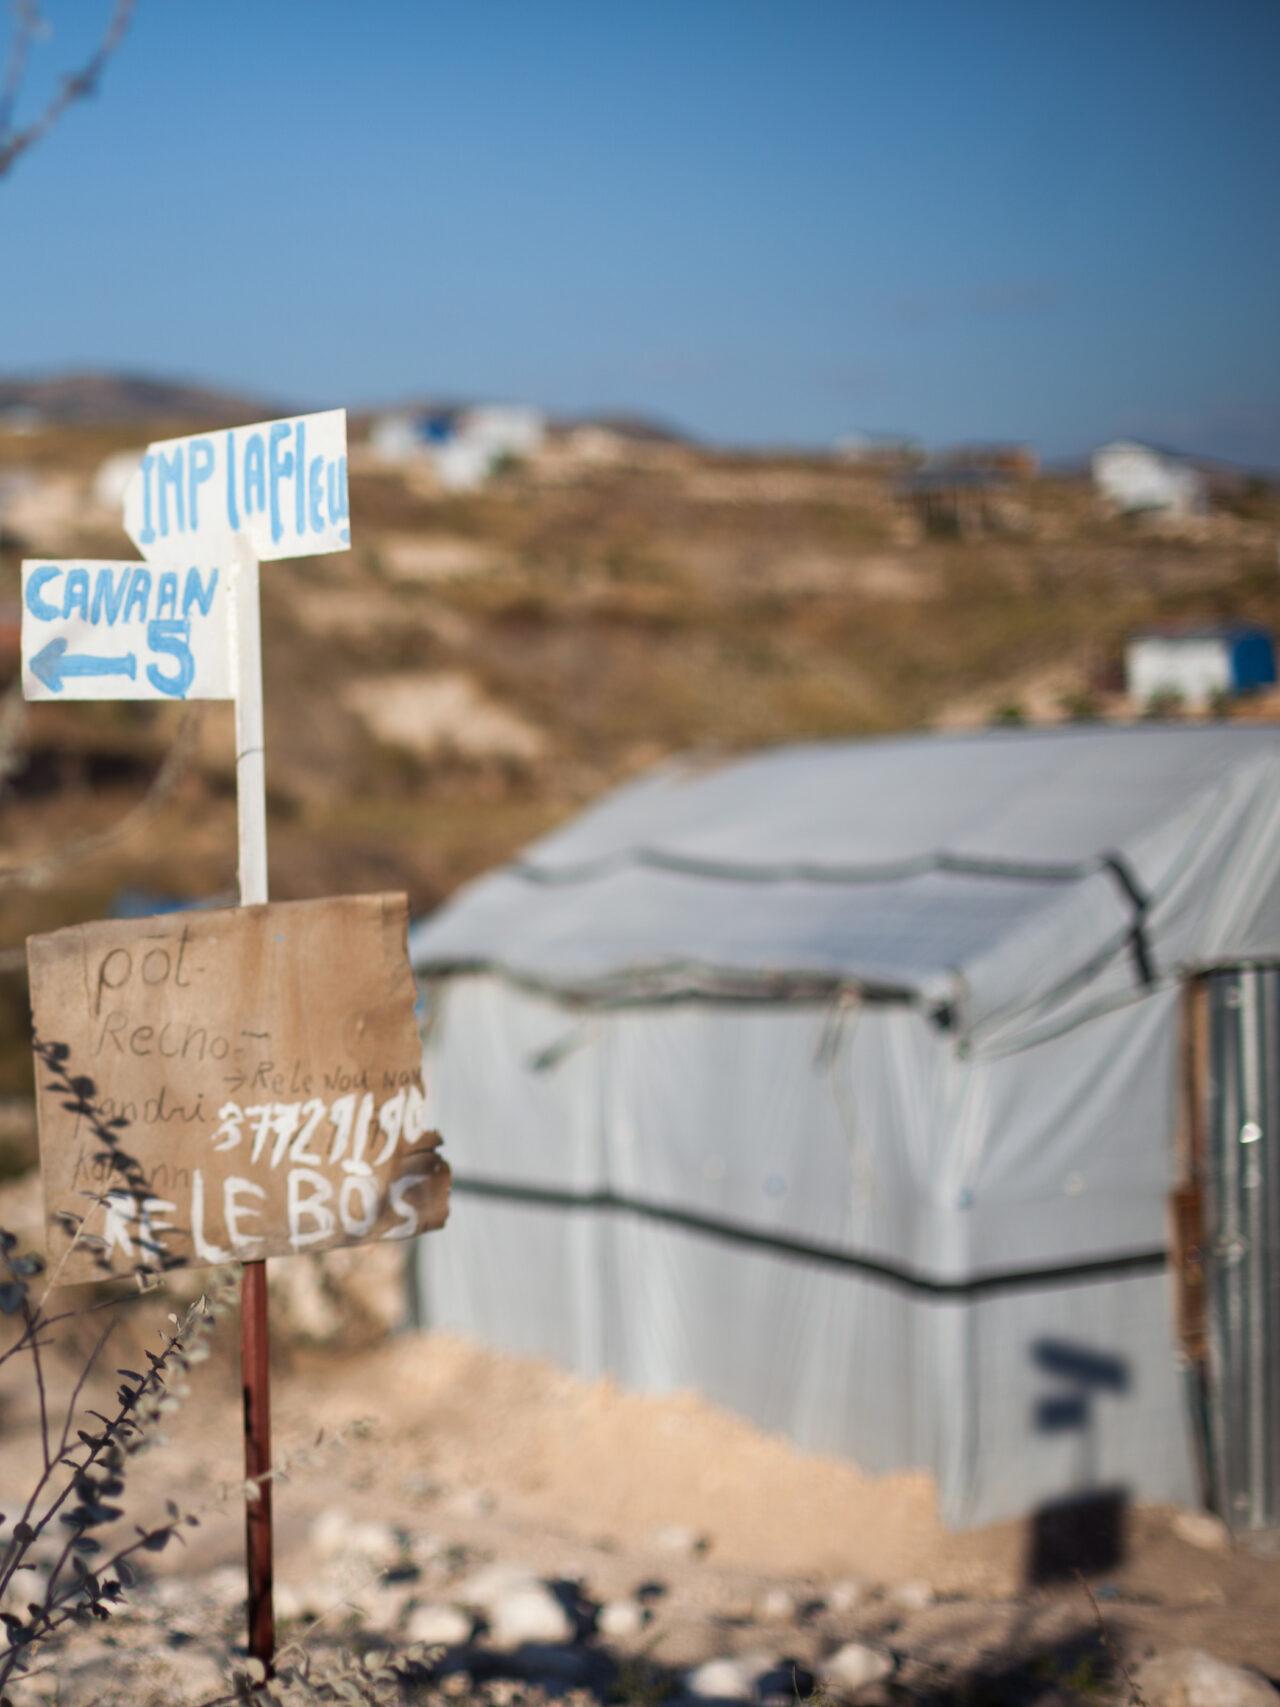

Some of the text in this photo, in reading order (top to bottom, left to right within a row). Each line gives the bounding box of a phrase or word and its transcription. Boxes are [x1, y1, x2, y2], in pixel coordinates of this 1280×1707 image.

[139, 438, 215, 545] IMP
[26, 566, 219, 627] CANAAN
[146, 619, 196, 700] 5
